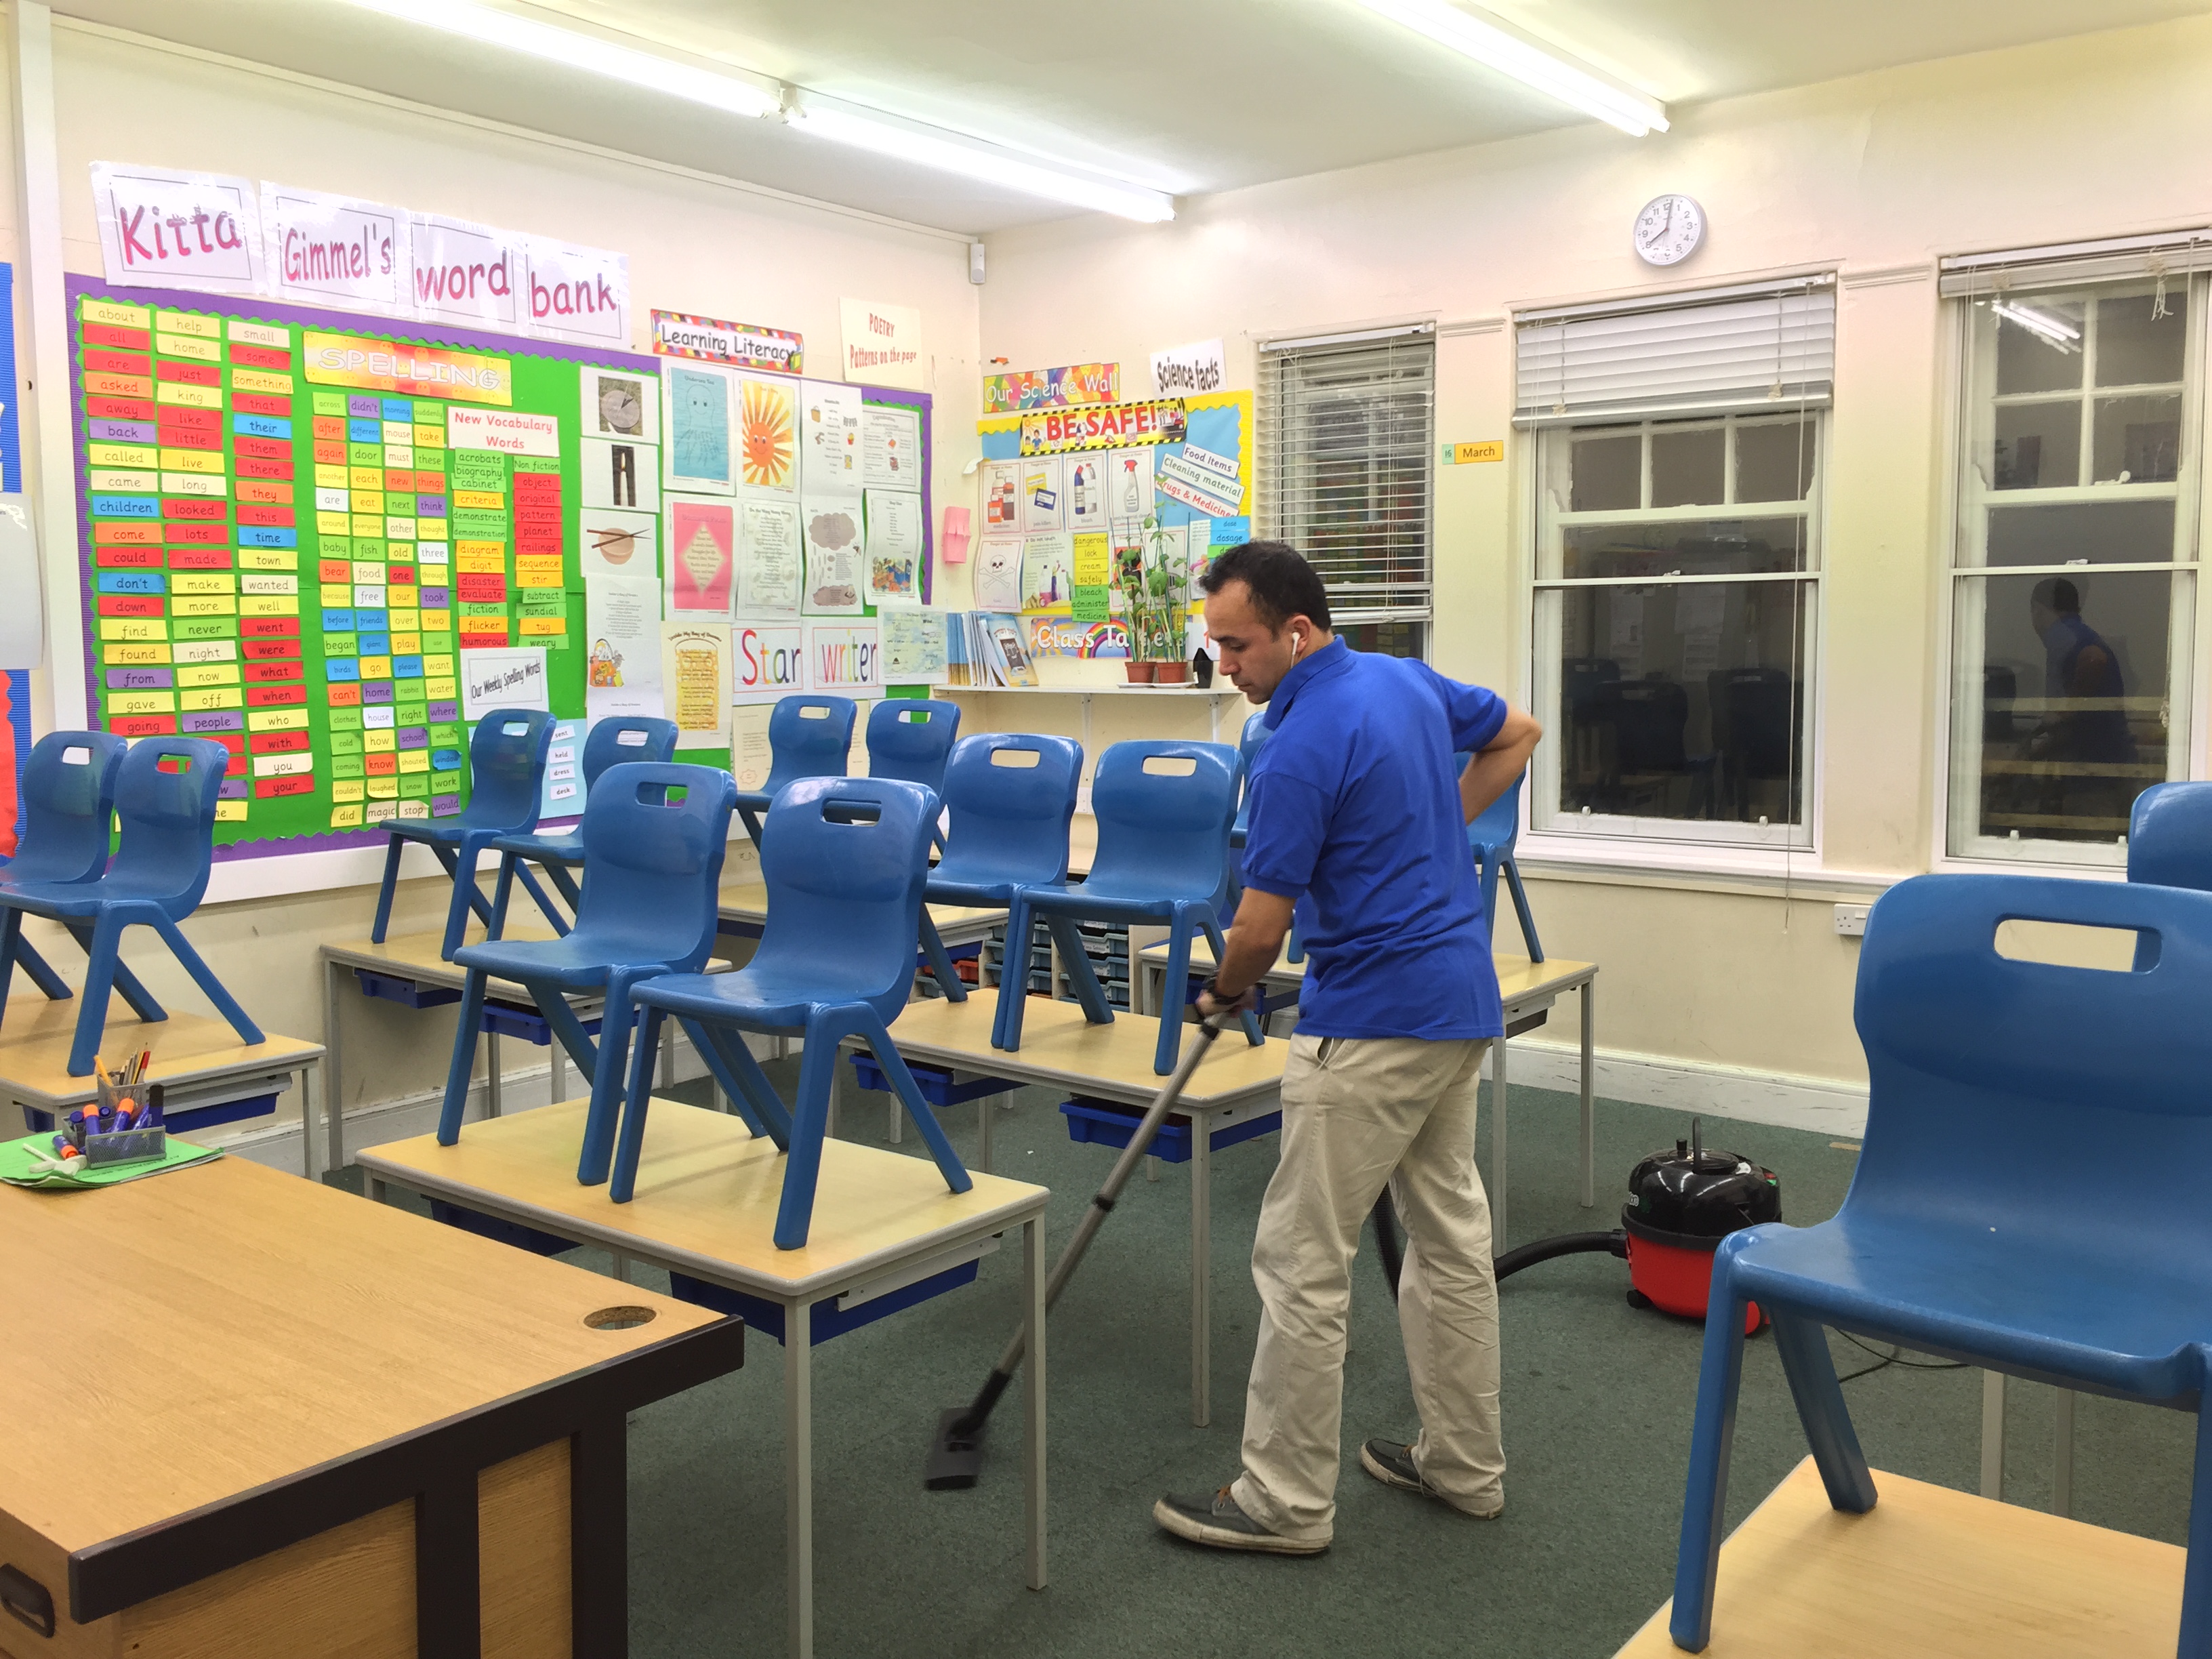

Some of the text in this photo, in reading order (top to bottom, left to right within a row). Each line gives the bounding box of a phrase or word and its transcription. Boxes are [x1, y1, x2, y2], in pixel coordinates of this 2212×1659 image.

[1645, 218, 1653, 226] 10
[119, 203, 617, 319] Kitta Gimmel's word bank
[98, 309, 135, 323] about
[176, 319, 202, 332] help
[869, 312, 895, 337] POETRY
[243, 329, 274, 342] small
[661, 323, 794, 361] Learning Literacy
[173, 342, 205, 355] home
[850, 344, 916, 369] Patterns on the page
[319, 348, 500, 390] SPELLING
[1158, 356, 1220, 393] Science facts
[100, 380, 138, 393] asked
[234, 376, 291, 392] something
[986, 371, 1119, 403] Our Science Wall
[178, 390, 203, 405] king
[351, 401, 378, 412] didn't
[249, 420, 277, 434] their
[455, 412, 552, 434] New Vocabulary
[1046, 405, 1157, 441] BE SAFE!
[108, 426, 138, 438] back
[319, 424, 340, 436] after
[386, 430, 410, 438] mouse
[486, 436, 525, 449] Words
[317, 449, 344, 460] again
[355, 449, 377, 460] door
[1185, 447, 1206, 462] Food
[1462, 446, 1495, 457] March
[104, 451, 143, 464] called
[459, 453, 501, 464] acrobats
[532, 461, 560, 472] fiction
[456, 466, 502, 480] biography
[1164, 457, 1242, 497] Cleaning material
[356, 474, 378, 484] each
[461, 479, 497, 489] cabinet
[523, 478, 552, 489] object
[182, 478, 207, 493] long
[251, 487, 277, 502] they
[520, 494, 555, 506] original
[1183, 491, 1191, 499] &
[100, 501, 153, 514] children
[175, 505, 215, 516] looked
[453, 511, 506, 522] demonstrate
[520, 510, 556, 520] pattern
[185, 529, 208, 539] lots
[390, 525, 413, 533] other
[523, 527, 553, 536] planet
[255, 533, 281, 543] time
[1074, 537, 1107, 547] dangerous
[1216, 533, 1243, 544] dosage
[323, 542, 346, 556] baby
[360, 544, 377, 557] fish
[394, 548, 408, 558] old
[422, 548, 445, 558] three
[460, 546, 499, 556] diagram
[521, 543, 556, 554] railings
[114, 552, 146, 563] could
[256, 555, 281, 566] town
[470, 560, 492, 571] digit
[518, 560, 560, 570] sequence
[325, 566, 346, 576] bear
[358, 569, 381, 581] food
[116, 577, 148, 589] don't
[187, 579, 221, 590] make
[248, 580, 289, 591] wanted
[462, 577, 501, 586] disaster
[1080, 575, 1102, 585] safely
[425, 592, 445, 602] took
[461, 590, 503, 599] evaluate
[527, 591, 560, 600] subtract
[258, 601, 281, 611] well
[1071, 600, 1108, 608] administer
[467, 605, 499, 616] fiction
[525, 607, 557, 615] sundial
[188, 624, 222, 634] never
[256, 623, 284, 633] went
[468, 621, 500, 633] flicker
[121, 626, 148, 640] find
[1037, 625, 1094, 649] Class
[325, 640, 354, 653] began
[462, 637, 507, 645] humorous
[530, 638, 556, 649] weary
[188, 649, 220, 661] night
[741, 629, 876, 686] Star writer
[260, 666, 288, 677] what
[123, 673, 156, 687] from
[472, 659, 541, 699] Our Weekly Spelling Words
[333, 690, 356, 700] can't
[365, 687, 390, 697] home
[268, 716, 289, 726] who
[401, 711, 422, 722] right
[127, 722, 160, 735] going
[194, 717, 231, 729] people
[268, 737, 293, 749] with
[368, 759, 393, 769] know
[435, 777, 457, 787] work
[273, 782, 298, 795] your
[557, 787, 571, 795] desk
[434, 800, 459, 811] would
[367, 807, 395, 819] magic
[404, 806, 424, 817] stop
